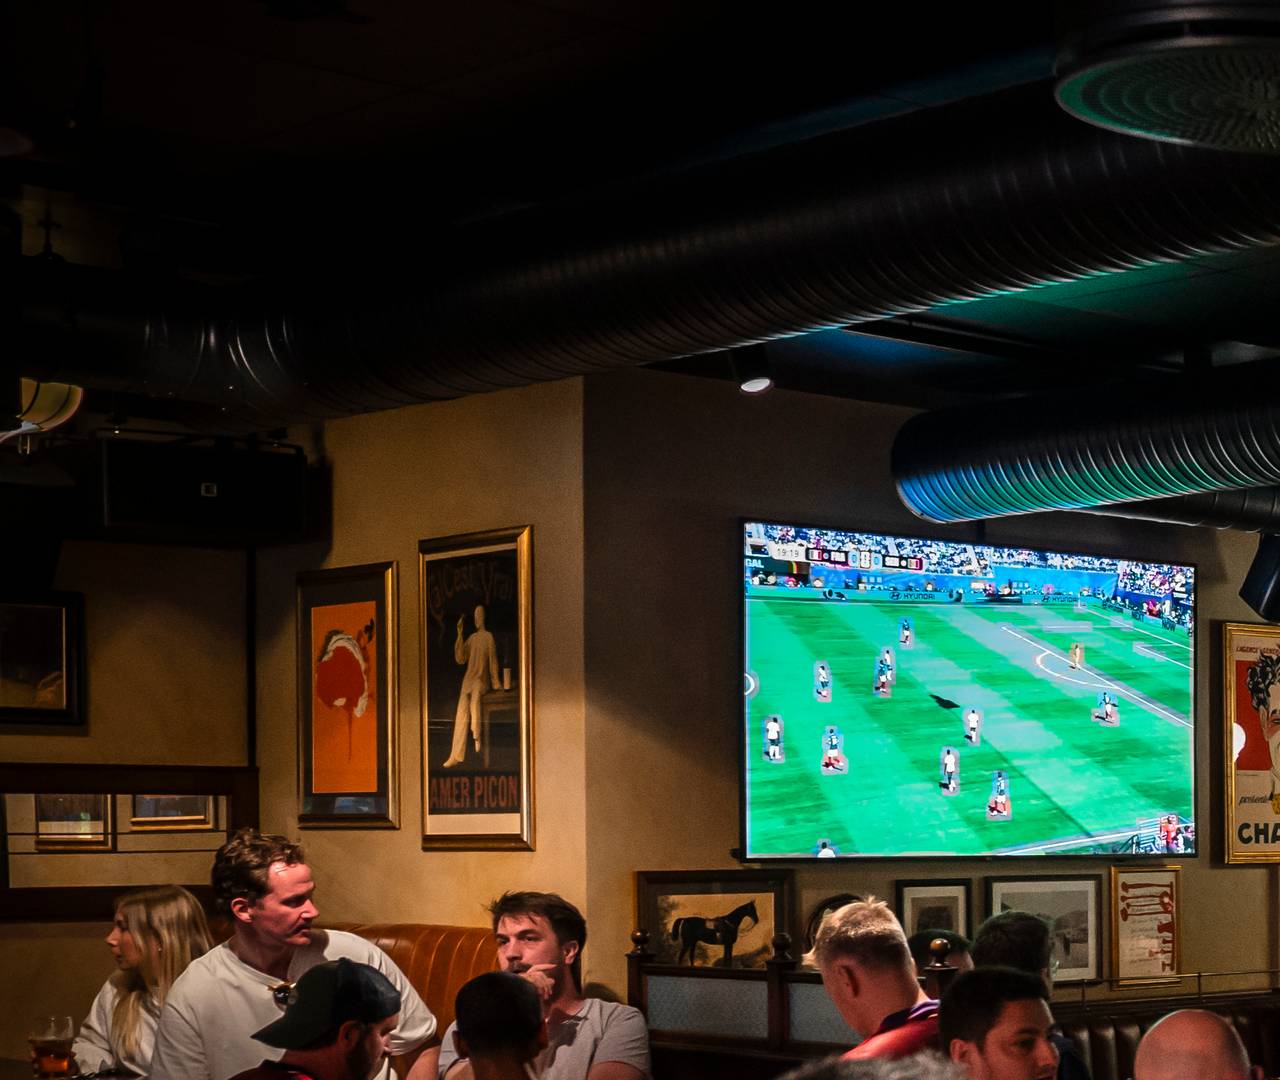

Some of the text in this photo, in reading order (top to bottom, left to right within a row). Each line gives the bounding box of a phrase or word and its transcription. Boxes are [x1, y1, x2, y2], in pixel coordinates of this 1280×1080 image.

[777, 547, 800, 558] 19:19
[431, 775, 518, 808] AMER PICON
